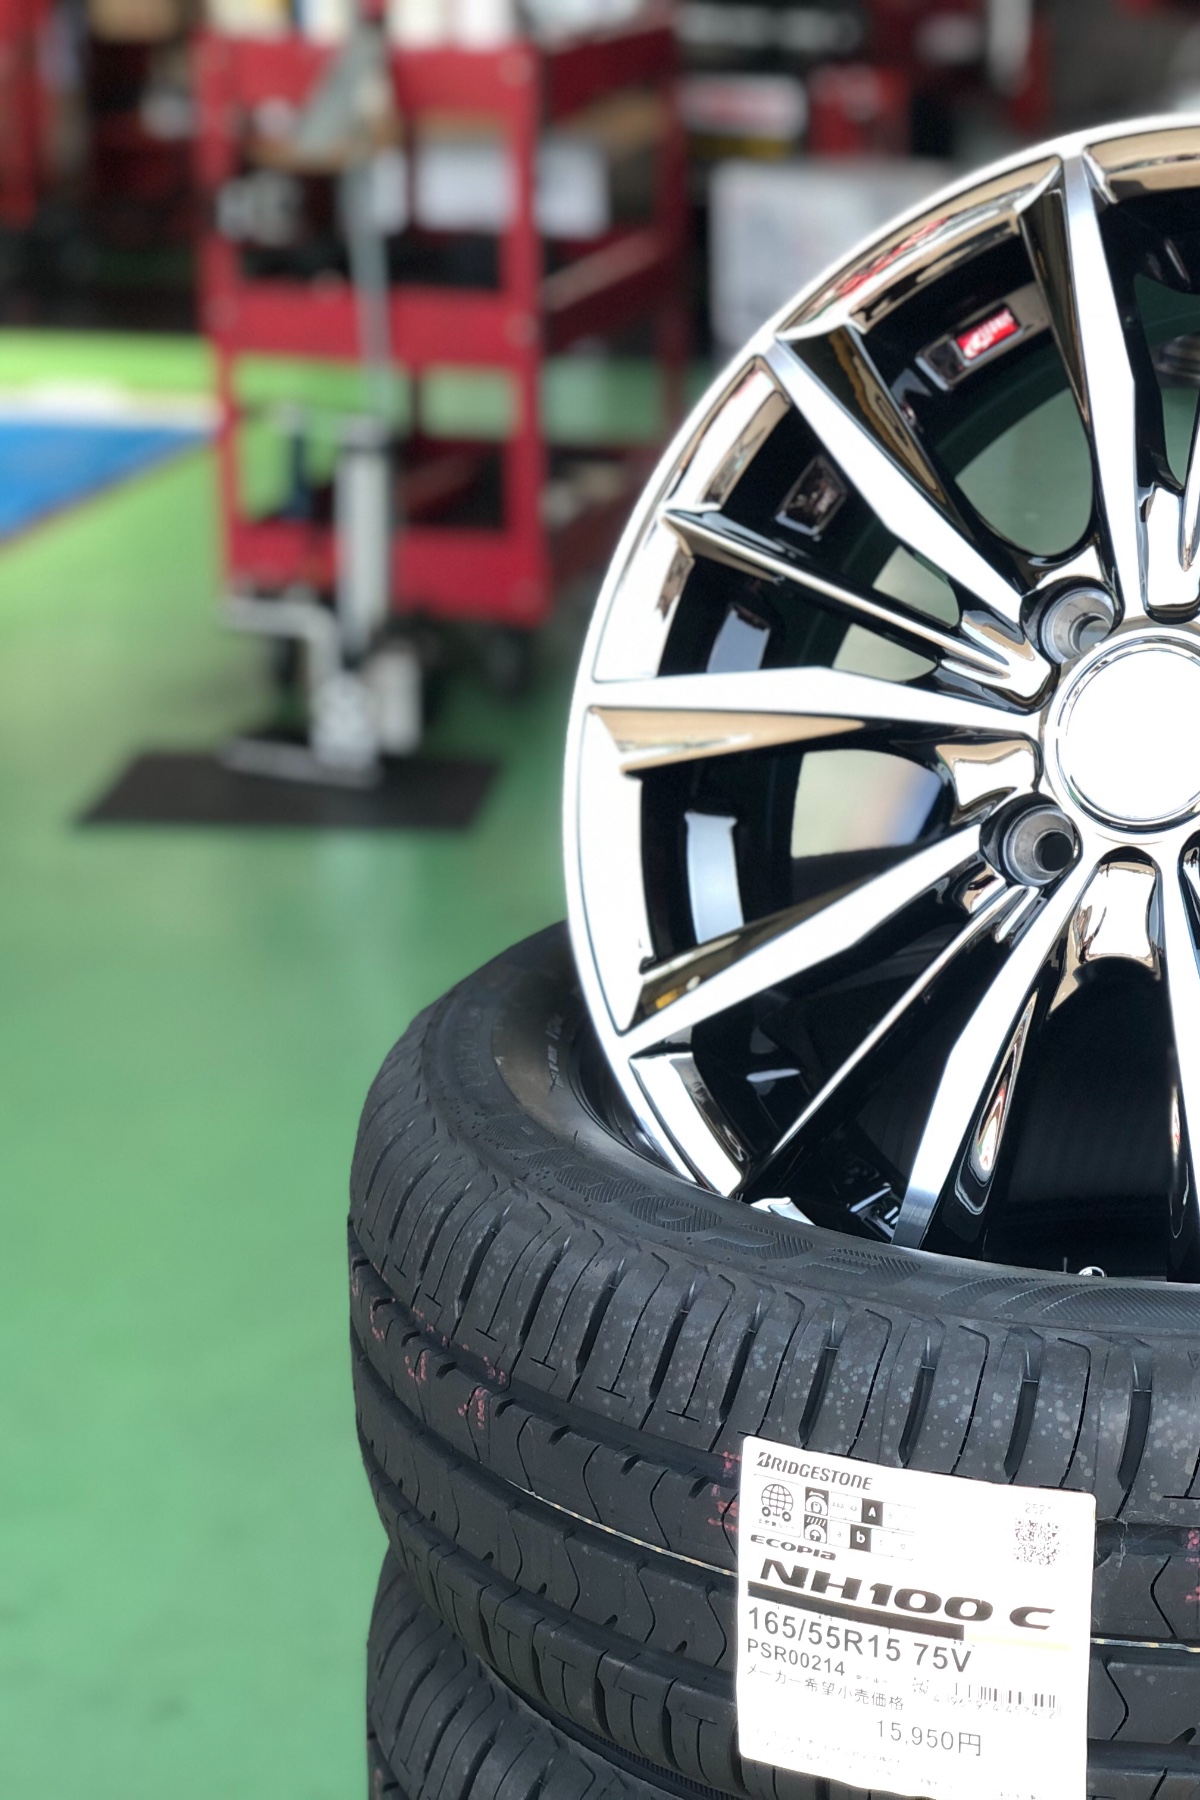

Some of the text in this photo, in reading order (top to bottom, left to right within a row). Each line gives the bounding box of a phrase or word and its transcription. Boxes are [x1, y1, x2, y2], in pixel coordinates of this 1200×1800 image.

[756, 1451, 873, 1490] BRIDGESTONE
[868, 1506, 877, 1518] A
[856, 1530, 866, 1544] b
[760, 1558, 1055, 1631] NH100 C
[747, 1638, 846, 1676] PSR00214
[748, 1606, 972, 1673] 165/55R15 75V
[747, 1663, 904, 1711] メーカー希望小売価格
[876, 1719, 982, 1757] 15,950円
